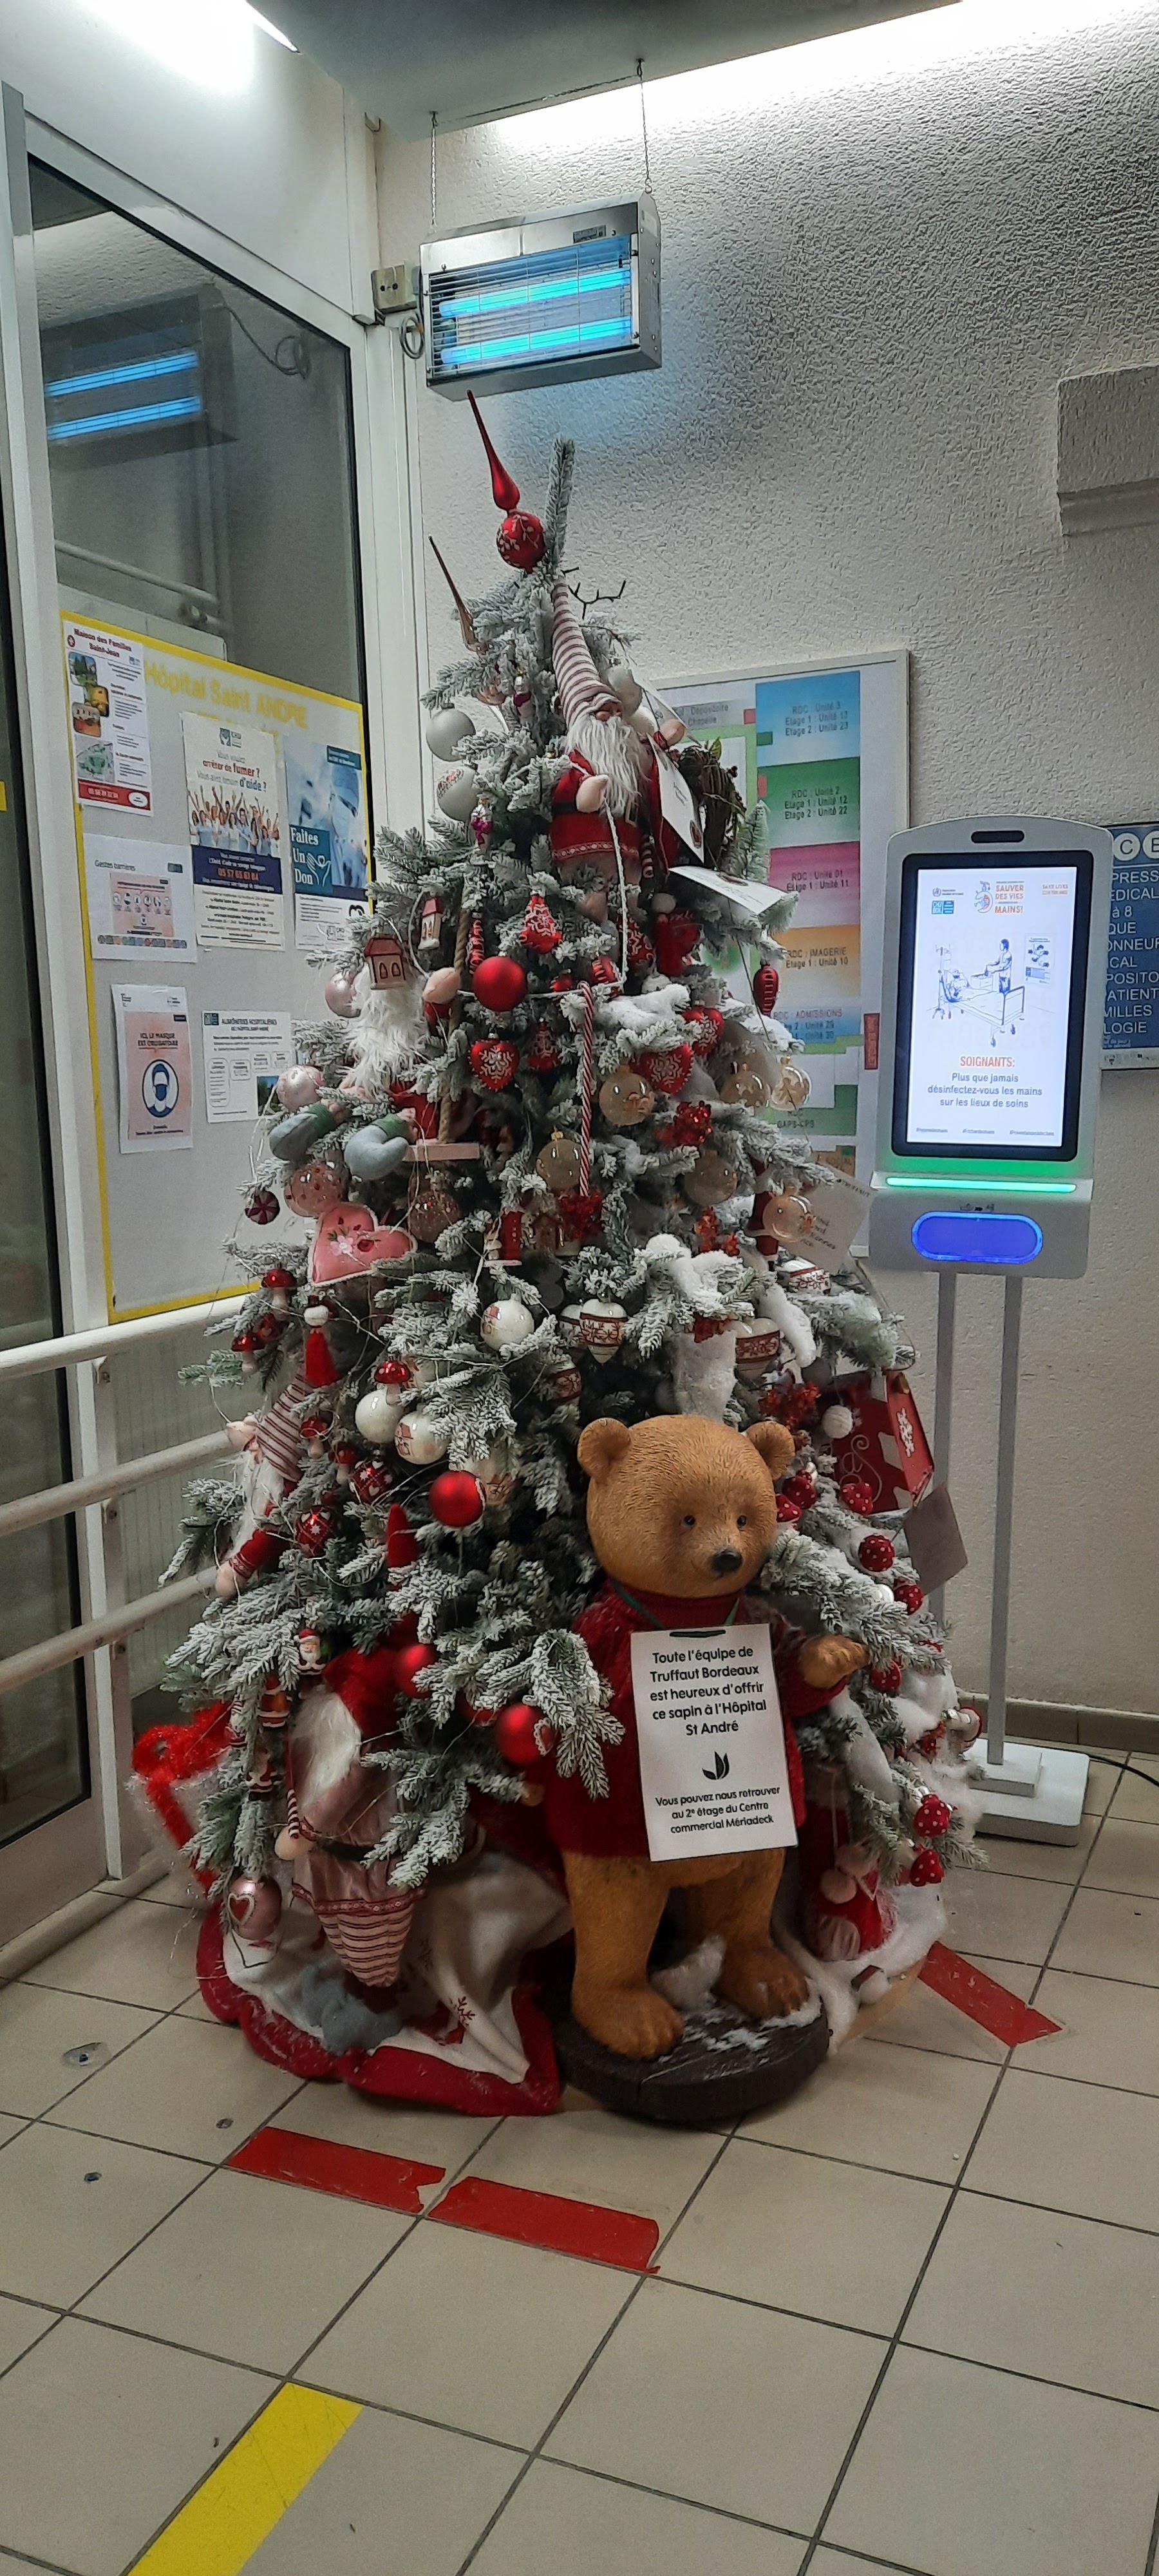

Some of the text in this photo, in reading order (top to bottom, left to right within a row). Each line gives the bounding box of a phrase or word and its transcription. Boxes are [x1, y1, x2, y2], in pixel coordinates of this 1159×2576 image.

[144, 659, 207, 696] Hôpital
[210, 679, 251, 712] Saint
[792, 705, 808, 714] RDC
[815, 701, 834, 712] Unité
[785, 716, 805, 726] Etage
[818, 711, 836, 722] Unité
[785, 727, 805, 737] Etage
[807, 725, 811, 734] 2
[818, 722, 837, 732] Unité
[840, 721, 848, 730] 23
[202, 760, 223, 770] arrêter
[233, 762, 255, 777] fumer
[256, 768, 260, 778] ?
[240, 777, 262, 791] d'aide
[263, 781, 267, 793] ?
[791, 789, 807, 799] RDC
[815, 788, 833, 796] Unité
[785, 800, 804, 810] Etage
[818, 796, 836, 806] Unité
[840, 795, 847, 804] 12
[785, 811, 805, 820] Etage
[807, 809, 811, 818] 2
[818, 806, 837, 817] Unité
[838, 805, 847, 815] 22
[290, 826, 319, 846] Faites
[1120, 839, 1133, 855] C
[292, 847, 306, 864] Un
[294, 867, 314, 886] Don
[791, 872, 807, 881] RDC
[815, 870, 833, 880] Unité
[820, 880, 838, 889] Unité
[841, 879, 849, 887] 11
[995, 884, 1024, 893] SAUVER
[994, 905, 1023, 914] MAINS!
[1112, 905, 1133, 918] à 8
[810, 946, 847, 958] IMAGERIE
[786, 960, 806, 969] Etage
[818, 958, 838, 967] Unité
[840, 956, 849, 965] 10
[795, 1008, 842, 1019] ADMISSIONS
[959, 1056, 1015, 1068] SOIGNANTS:
[952, 1072, 1019, 1084] Plus que jamais
[928, 1084, 1043, 1096] désinfectez-vous les mains
[956, 1097, 968, 1106] les
[970, 1098, 990, 1108] lieux
[992, 1098, 1003, 1108] de
[1005, 1099, 1029, 1108] soins
[652, 1645, 754, 1664] Toute l'équipe de
[650, 1665, 760, 1683] Truffaut Bordeaux
[650, 1681, 764, 1701] est heureux d'offrir
[652, 1699, 767, 1720] ce sapin à l'Hôpital
[686, 1720, 739, 1736] St André
[655, 1786, 780, 1806] Vous pouvez nous retrouver
[672, 1810, 684, 1819] au
[697, 1805, 724, 1817] étage
[726, 1804, 738, 1814] du
[739, 1802, 769, 1812] Centre
[670, 1814, 775, 1833] commercial Mériadeck
